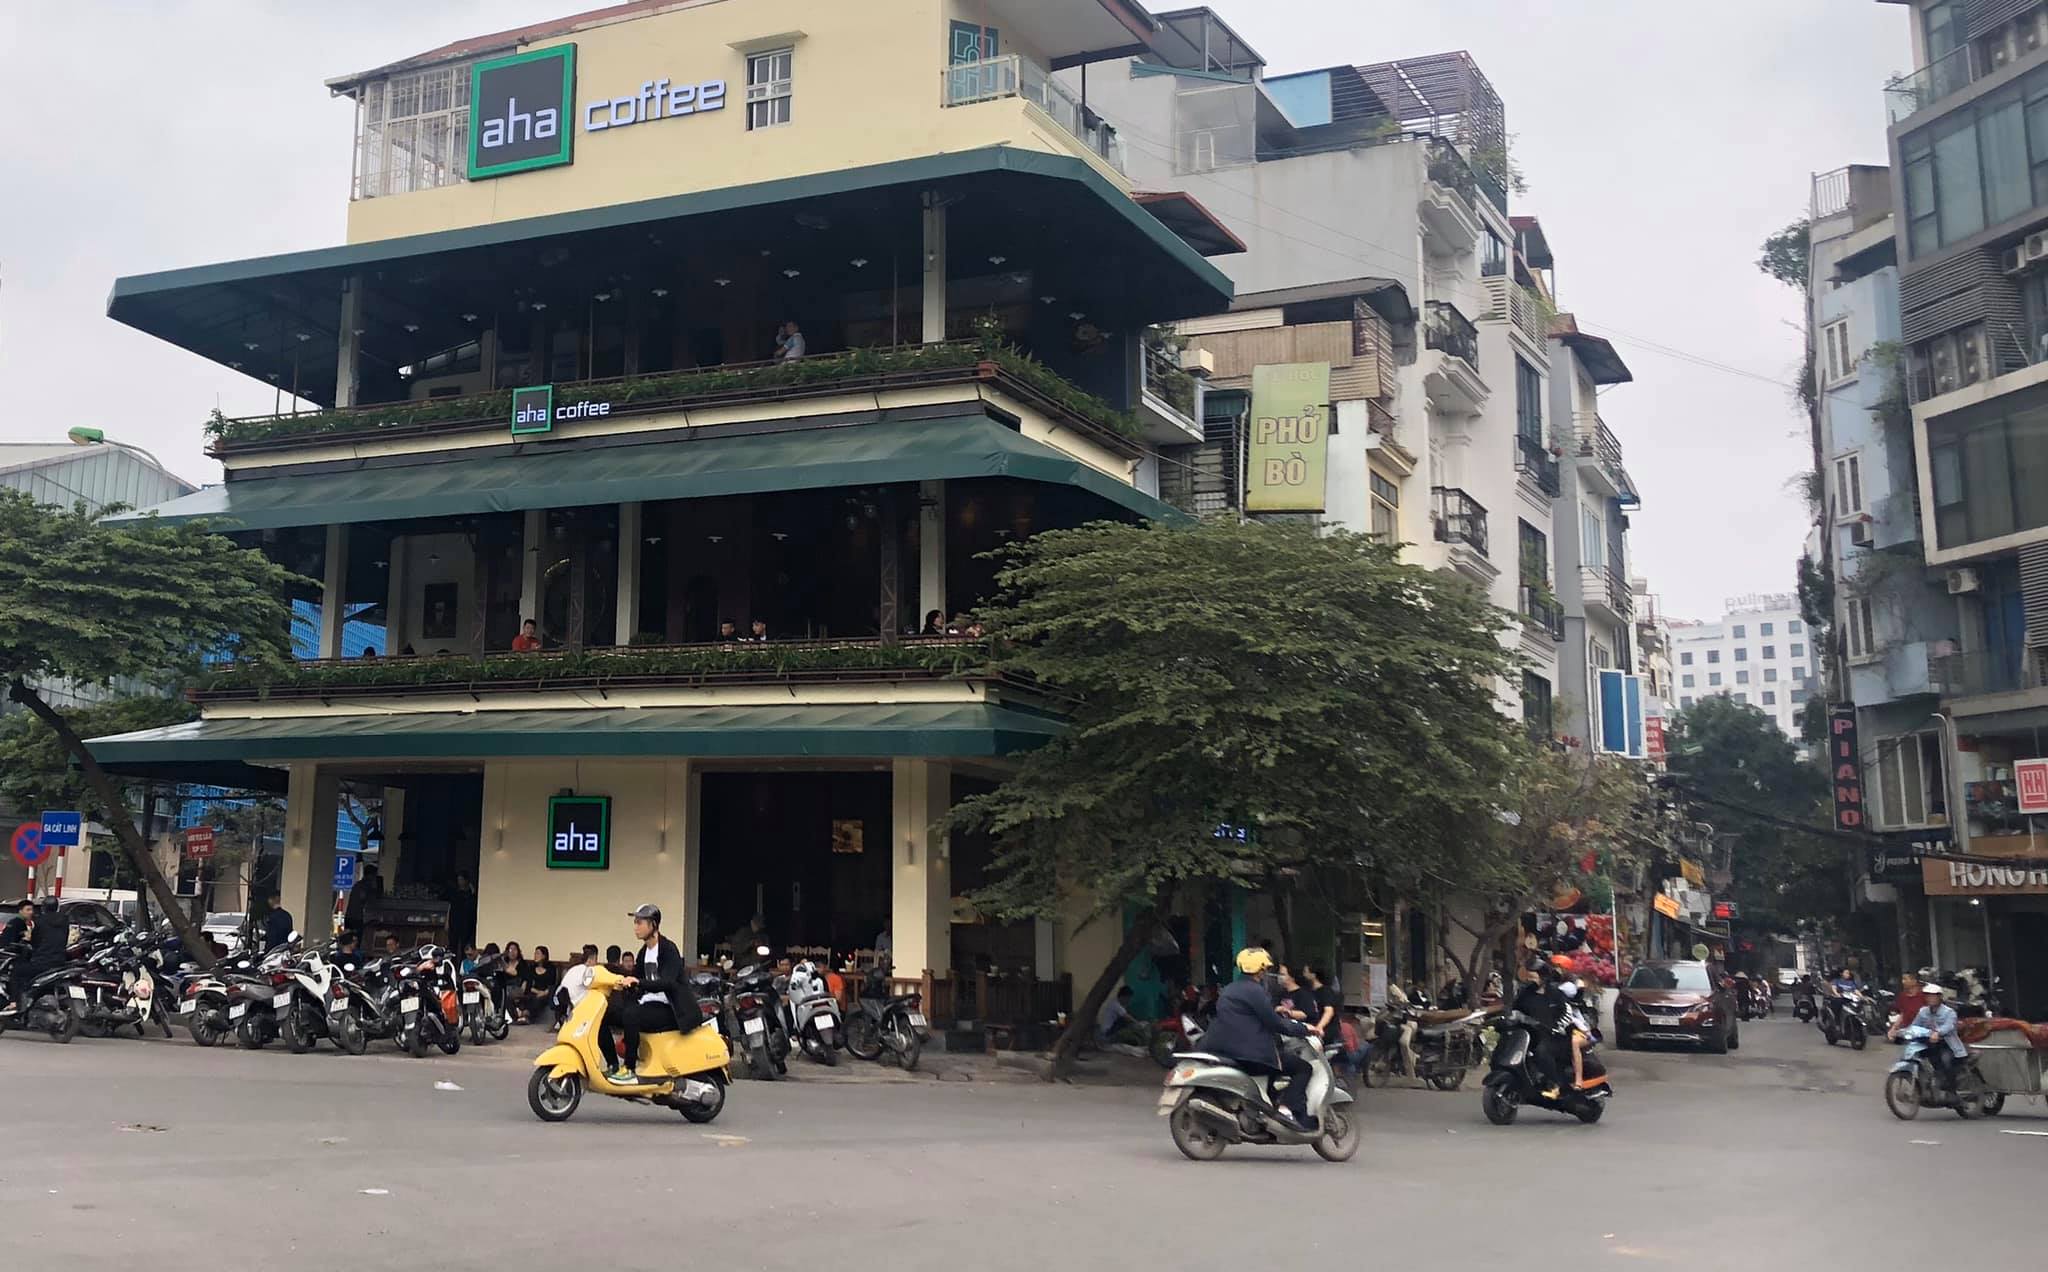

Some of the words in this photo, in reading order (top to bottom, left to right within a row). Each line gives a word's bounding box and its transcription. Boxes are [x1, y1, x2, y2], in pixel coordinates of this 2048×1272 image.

[482, 98, 557, 148] aha
[583, 78, 726, 132] coffee
[516, 403, 547, 423] aha
[556, 401, 610, 419] coffee
[1256, 404, 1322, 445] PHỞ
[1264, 451, 1306, 486] BÒ
[1833, 718, 1861, 827] PIANO
[555, 822, 598, 851] aha
[338, 857, 349, 873] P
